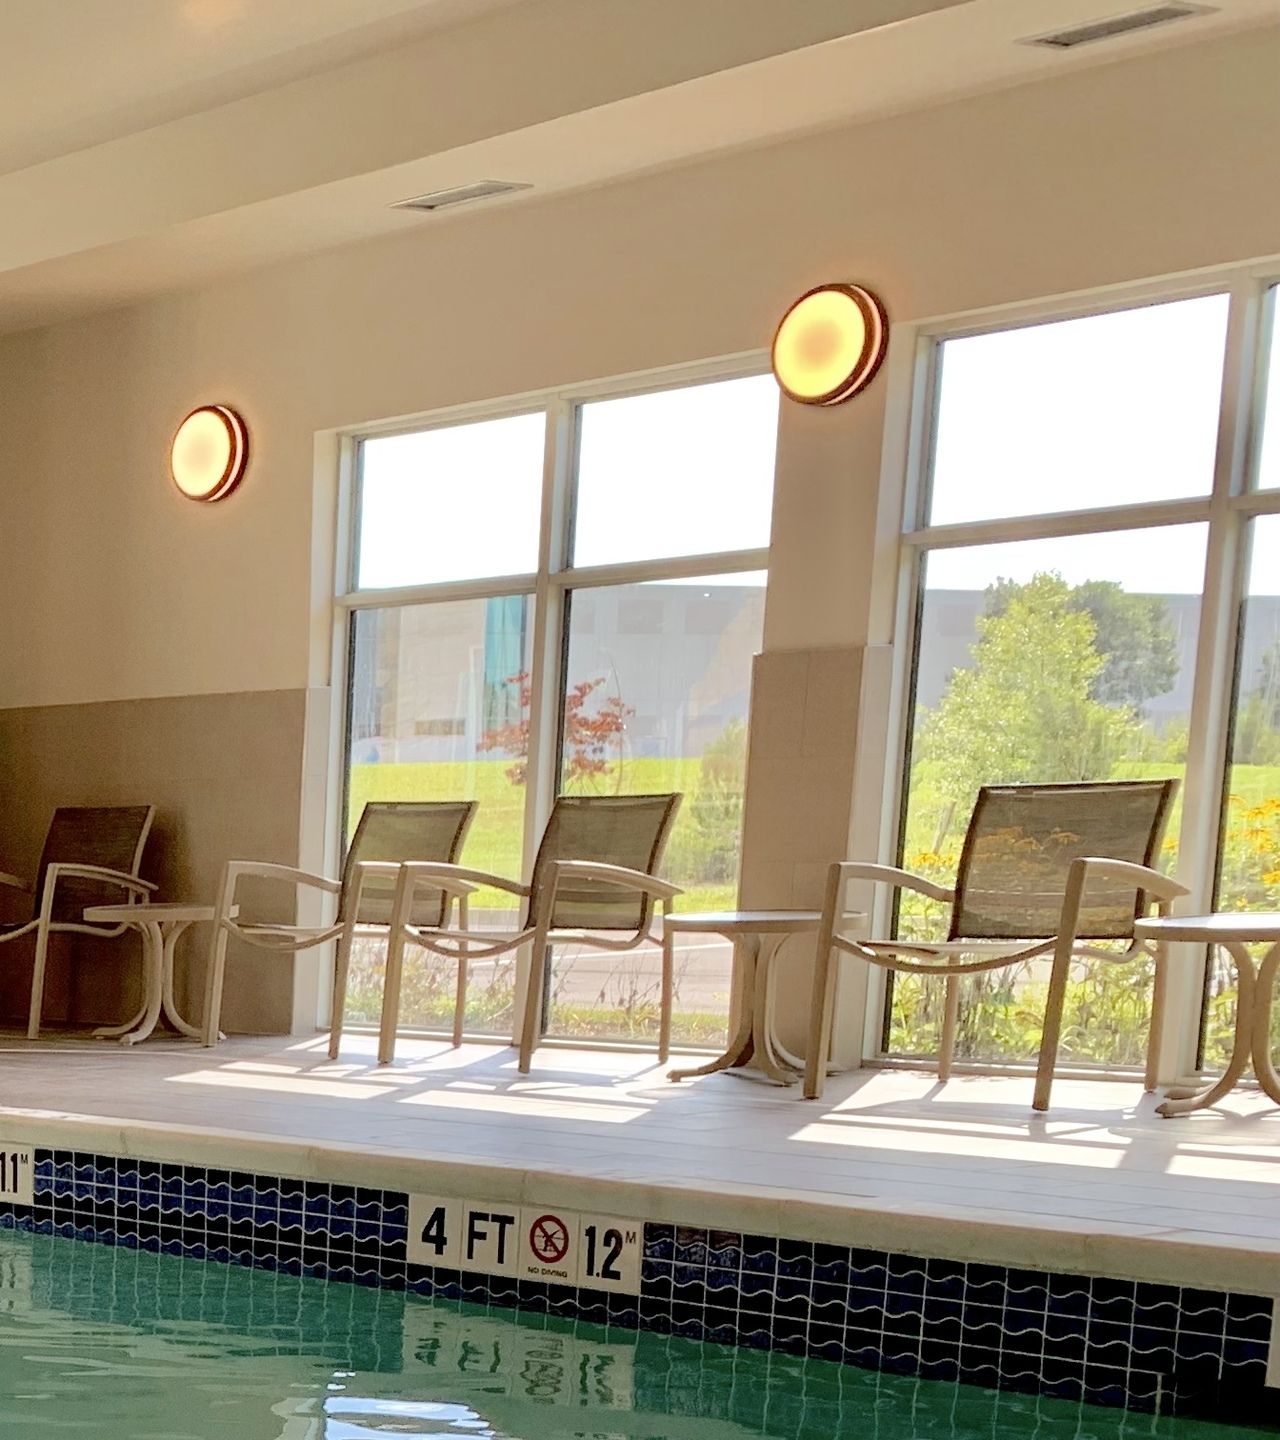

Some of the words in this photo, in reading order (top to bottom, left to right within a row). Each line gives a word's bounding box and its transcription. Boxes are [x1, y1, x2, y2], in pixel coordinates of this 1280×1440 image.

[421, 1206, 448, 1256] 4
[467, 1211, 515, 1264] FT
[527, 1266, 539, 1275] NO
[541, 1267, 568, 1278] DIVING
